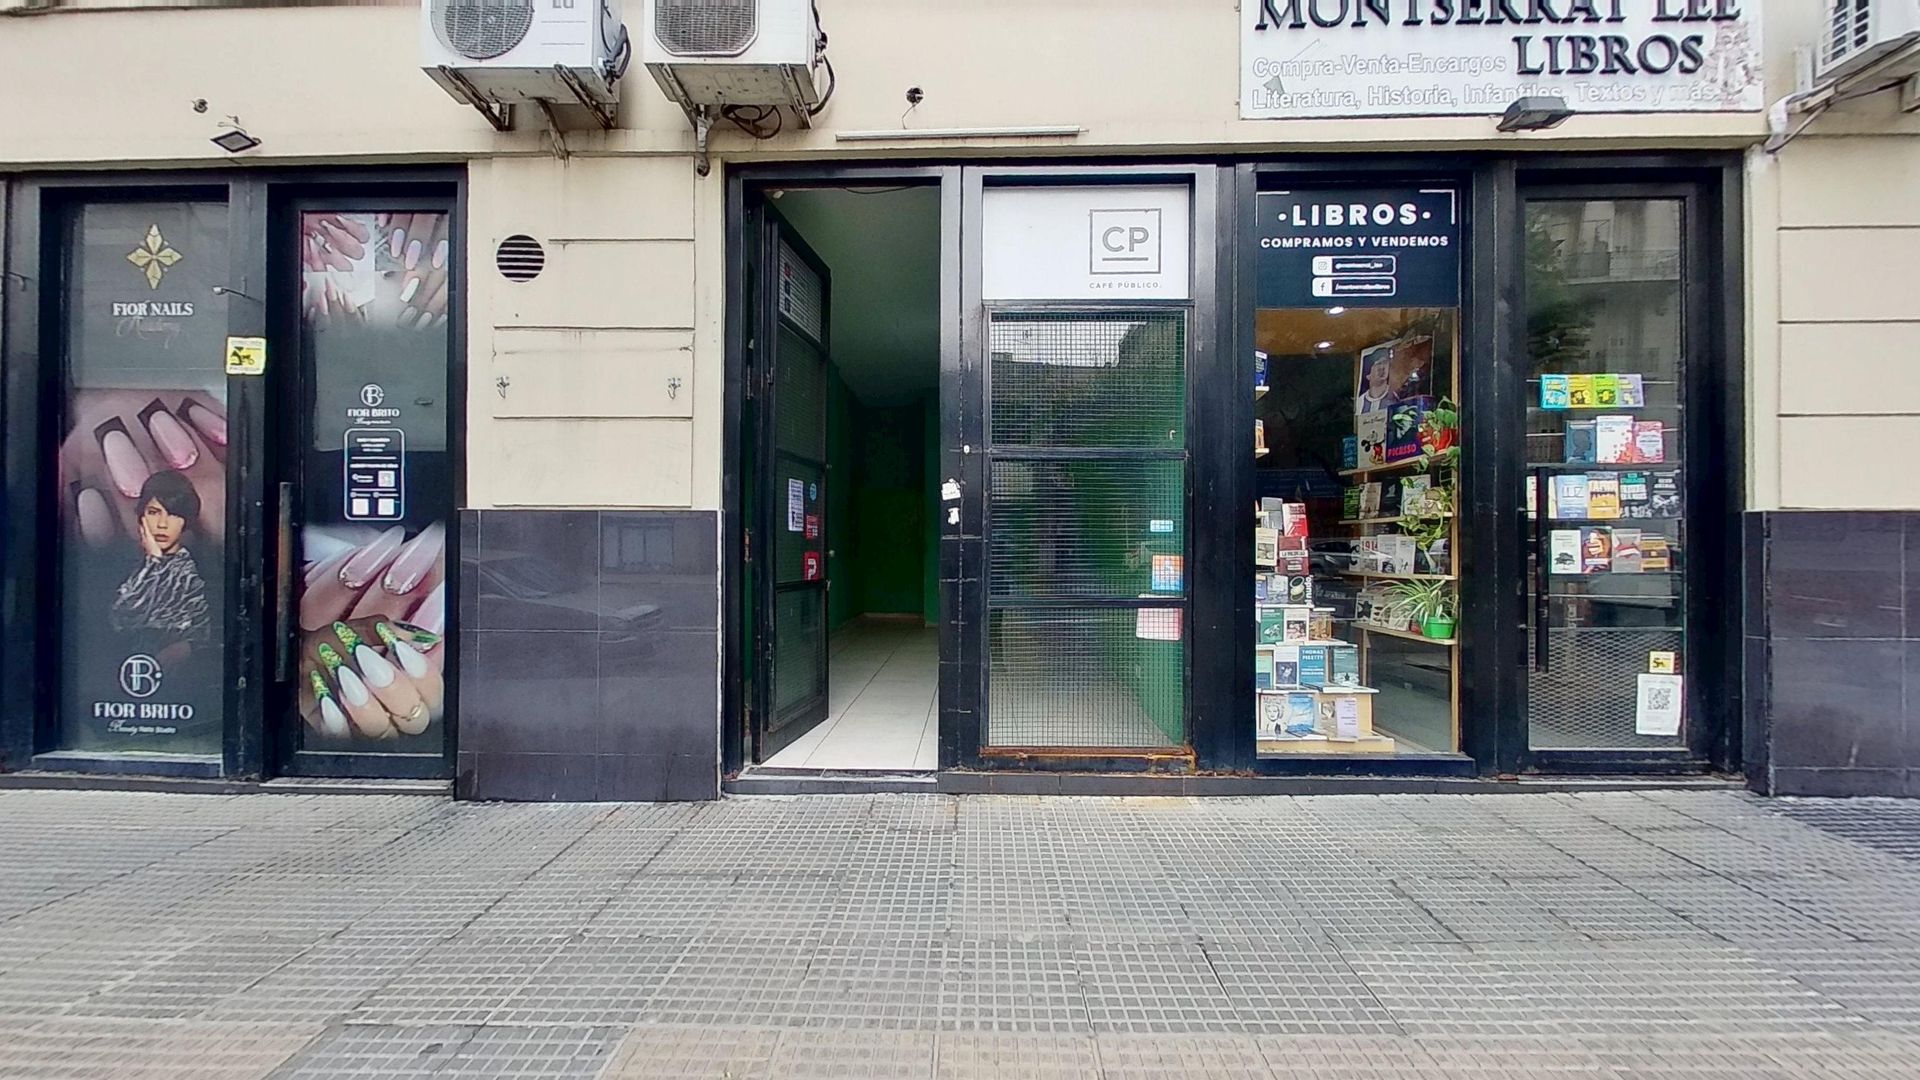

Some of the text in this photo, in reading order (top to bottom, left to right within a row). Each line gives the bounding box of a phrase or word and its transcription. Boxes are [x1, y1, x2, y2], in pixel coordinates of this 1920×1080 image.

[1511, 34, 1704, 75] LIBROS
[1253, 53, 1506, 80] Compra-Venta-Encargos
[1252, 86, 1361, 110] Literatura,
[1368, 84, 1458, 107] Historia,
[1575, 80, 1645, 101] Textos
[1102, 226, 1149, 252] CP
[1260, 235, 1449, 248] COMPRAMOS Y VENDEMOS
[112, 302, 194, 316] FIOR NAILS
[371, 408, 400, 417] BRITO
[94, 702, 193, 719] FIOR BRITO
